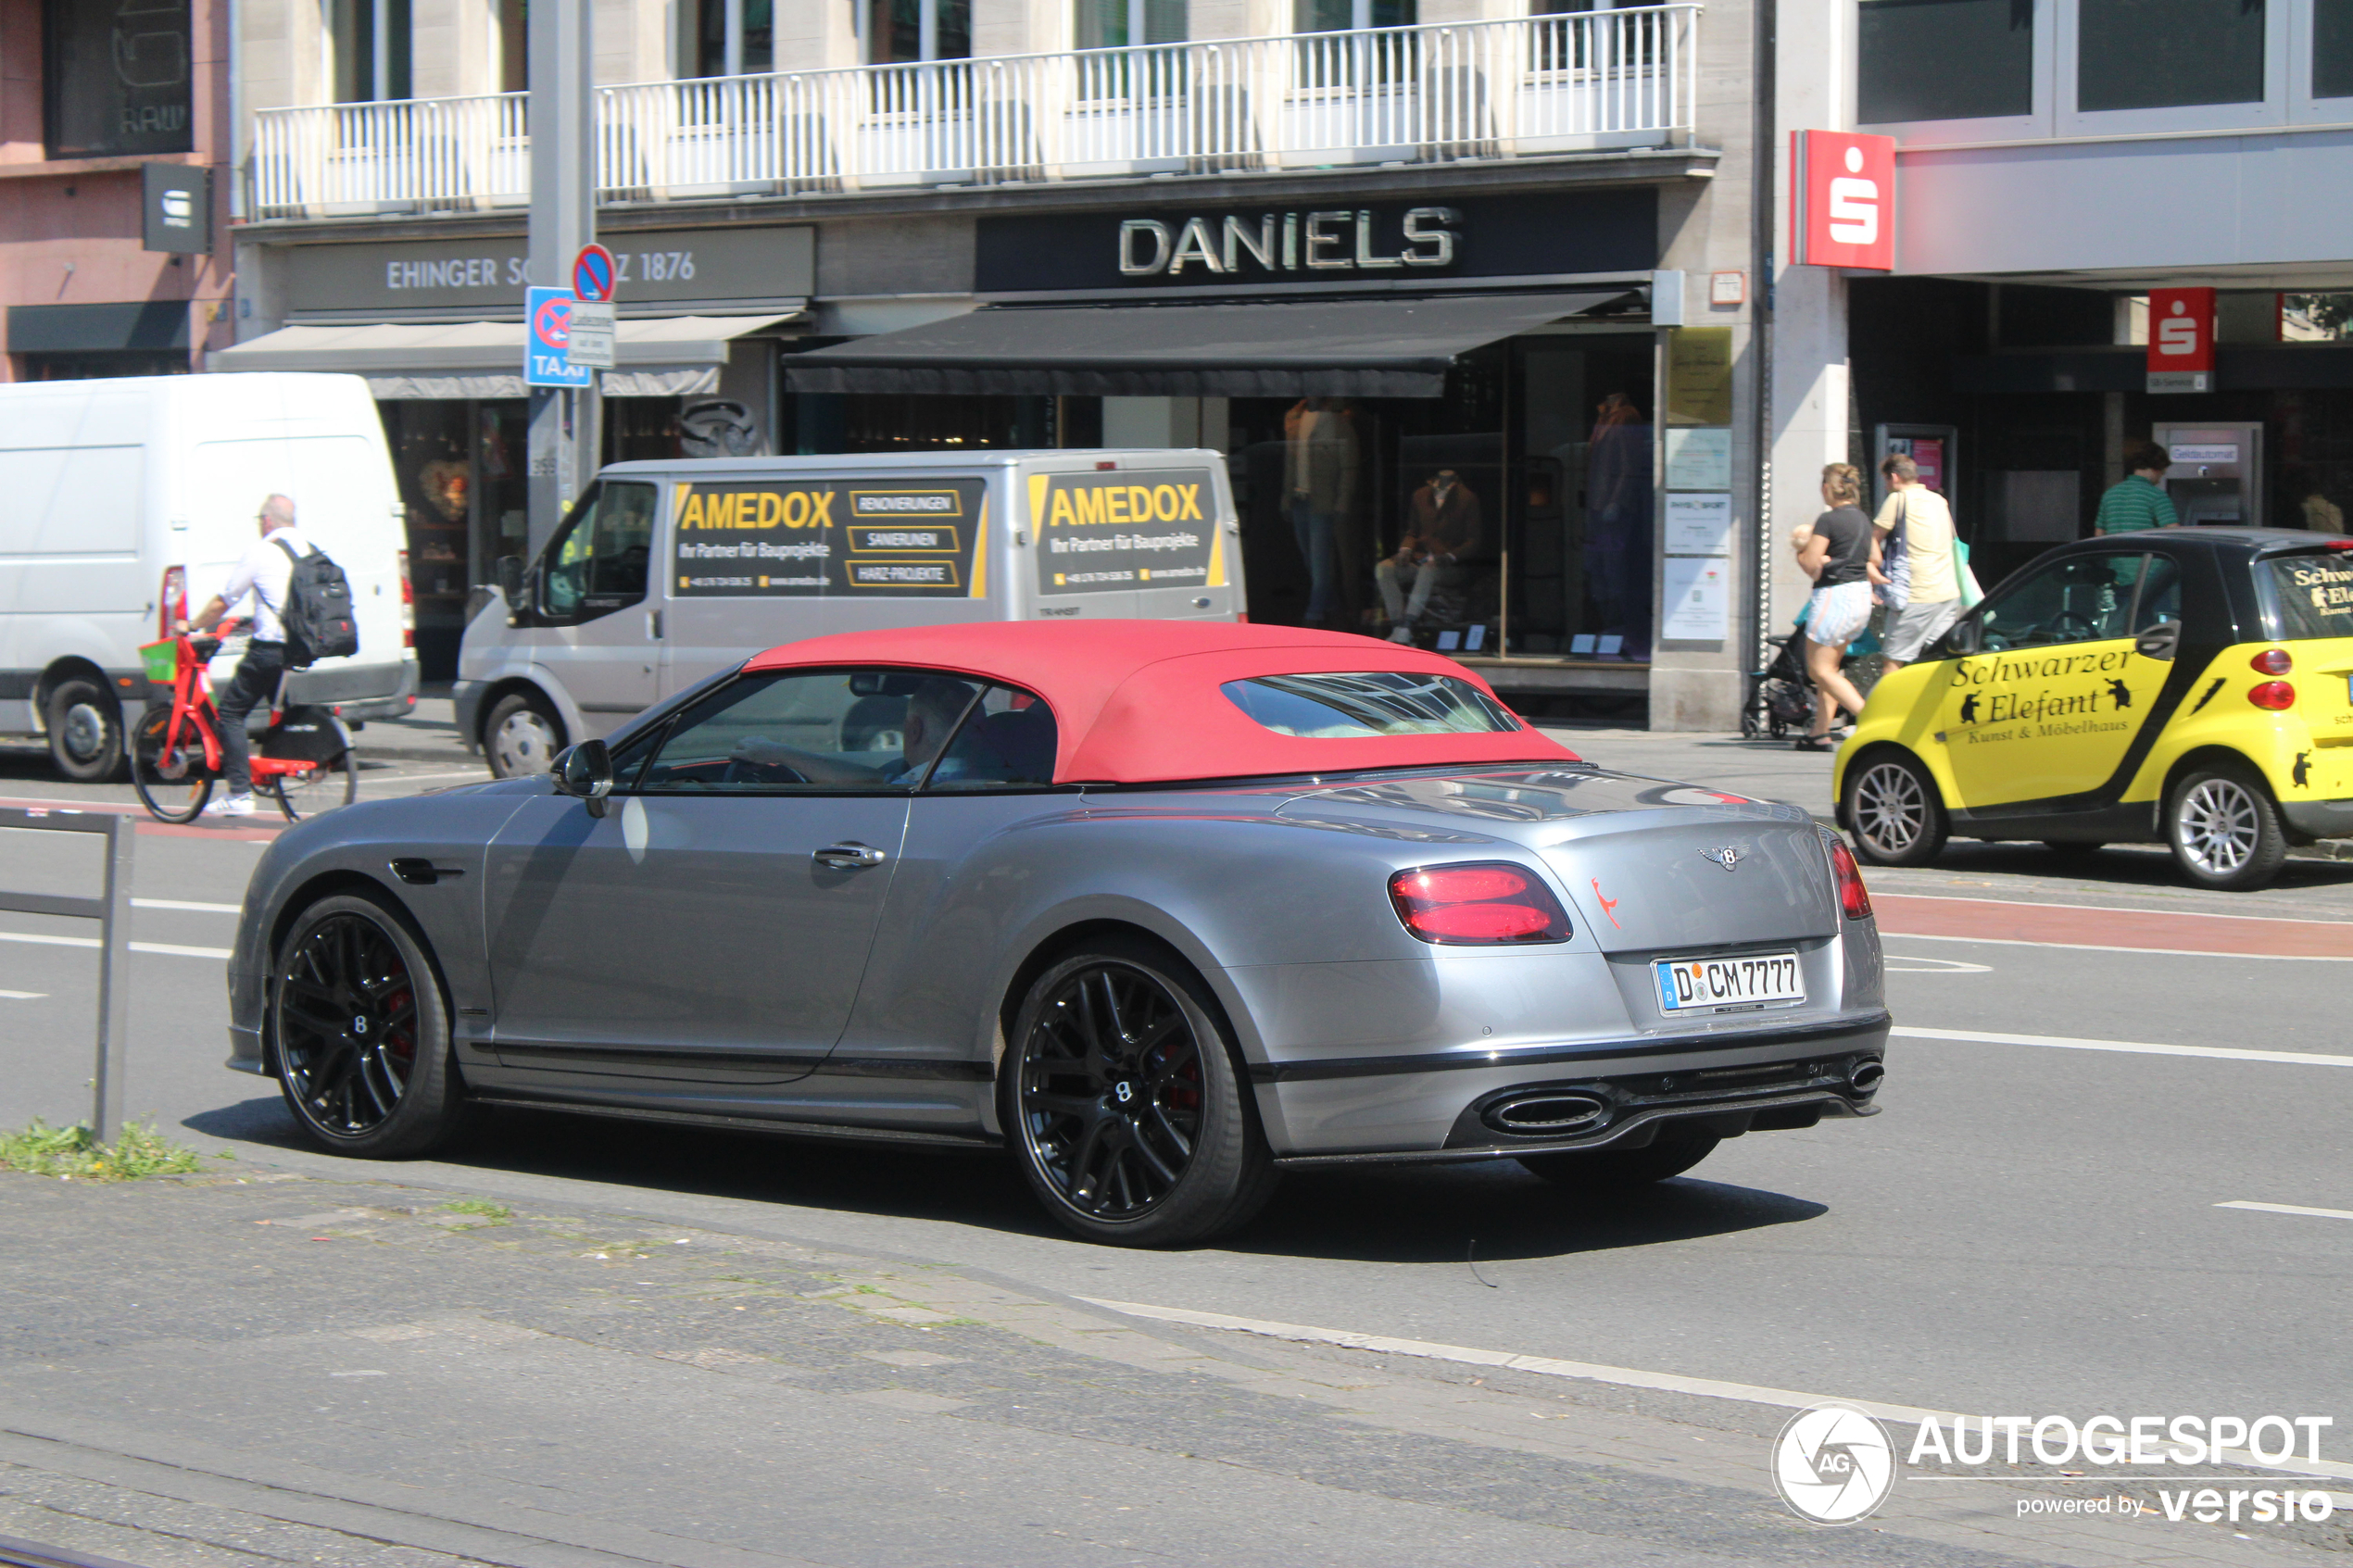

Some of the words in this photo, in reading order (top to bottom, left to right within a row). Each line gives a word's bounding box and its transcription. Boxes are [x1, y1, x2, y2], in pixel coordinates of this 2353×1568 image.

[1119, 207, 1453, 276] DANIELS
[387, 258, 497, 289] EHINGER
[641, 251, 695, 282] 1876
[680, 491, 836, 529] AMEDOX
[858, 496, 951, 510] RENOVIERUNGEN
[1050, 483, 1203, 526] AMEDOX
[679, 542, 696, 558] Ihr
[697, 542, 739, 558] Partner
[739, 541, 758, 558] für
[758, 541, 831, 561] Bauprojekte
[1051, 537, 1069, 553] Ihr
[1069, 537, 1114, 552] Partner
[1114, 534, 1132, 550] für
[1132, 532, 1200, 552] Bauprojekte
[858, 567, 946, 581] HARZ-PROJEKTE
[1952, 650, 2137, 687] Schwarzer
[1989, 689, 2099, 722] Elefant
[1968, 726, 2014, 745] Kunst
[2019, 726, 2032, 739] &
[2036, 720, 2129, 738] Möbelhaus
[1674, 968, 1693, 1001] D
